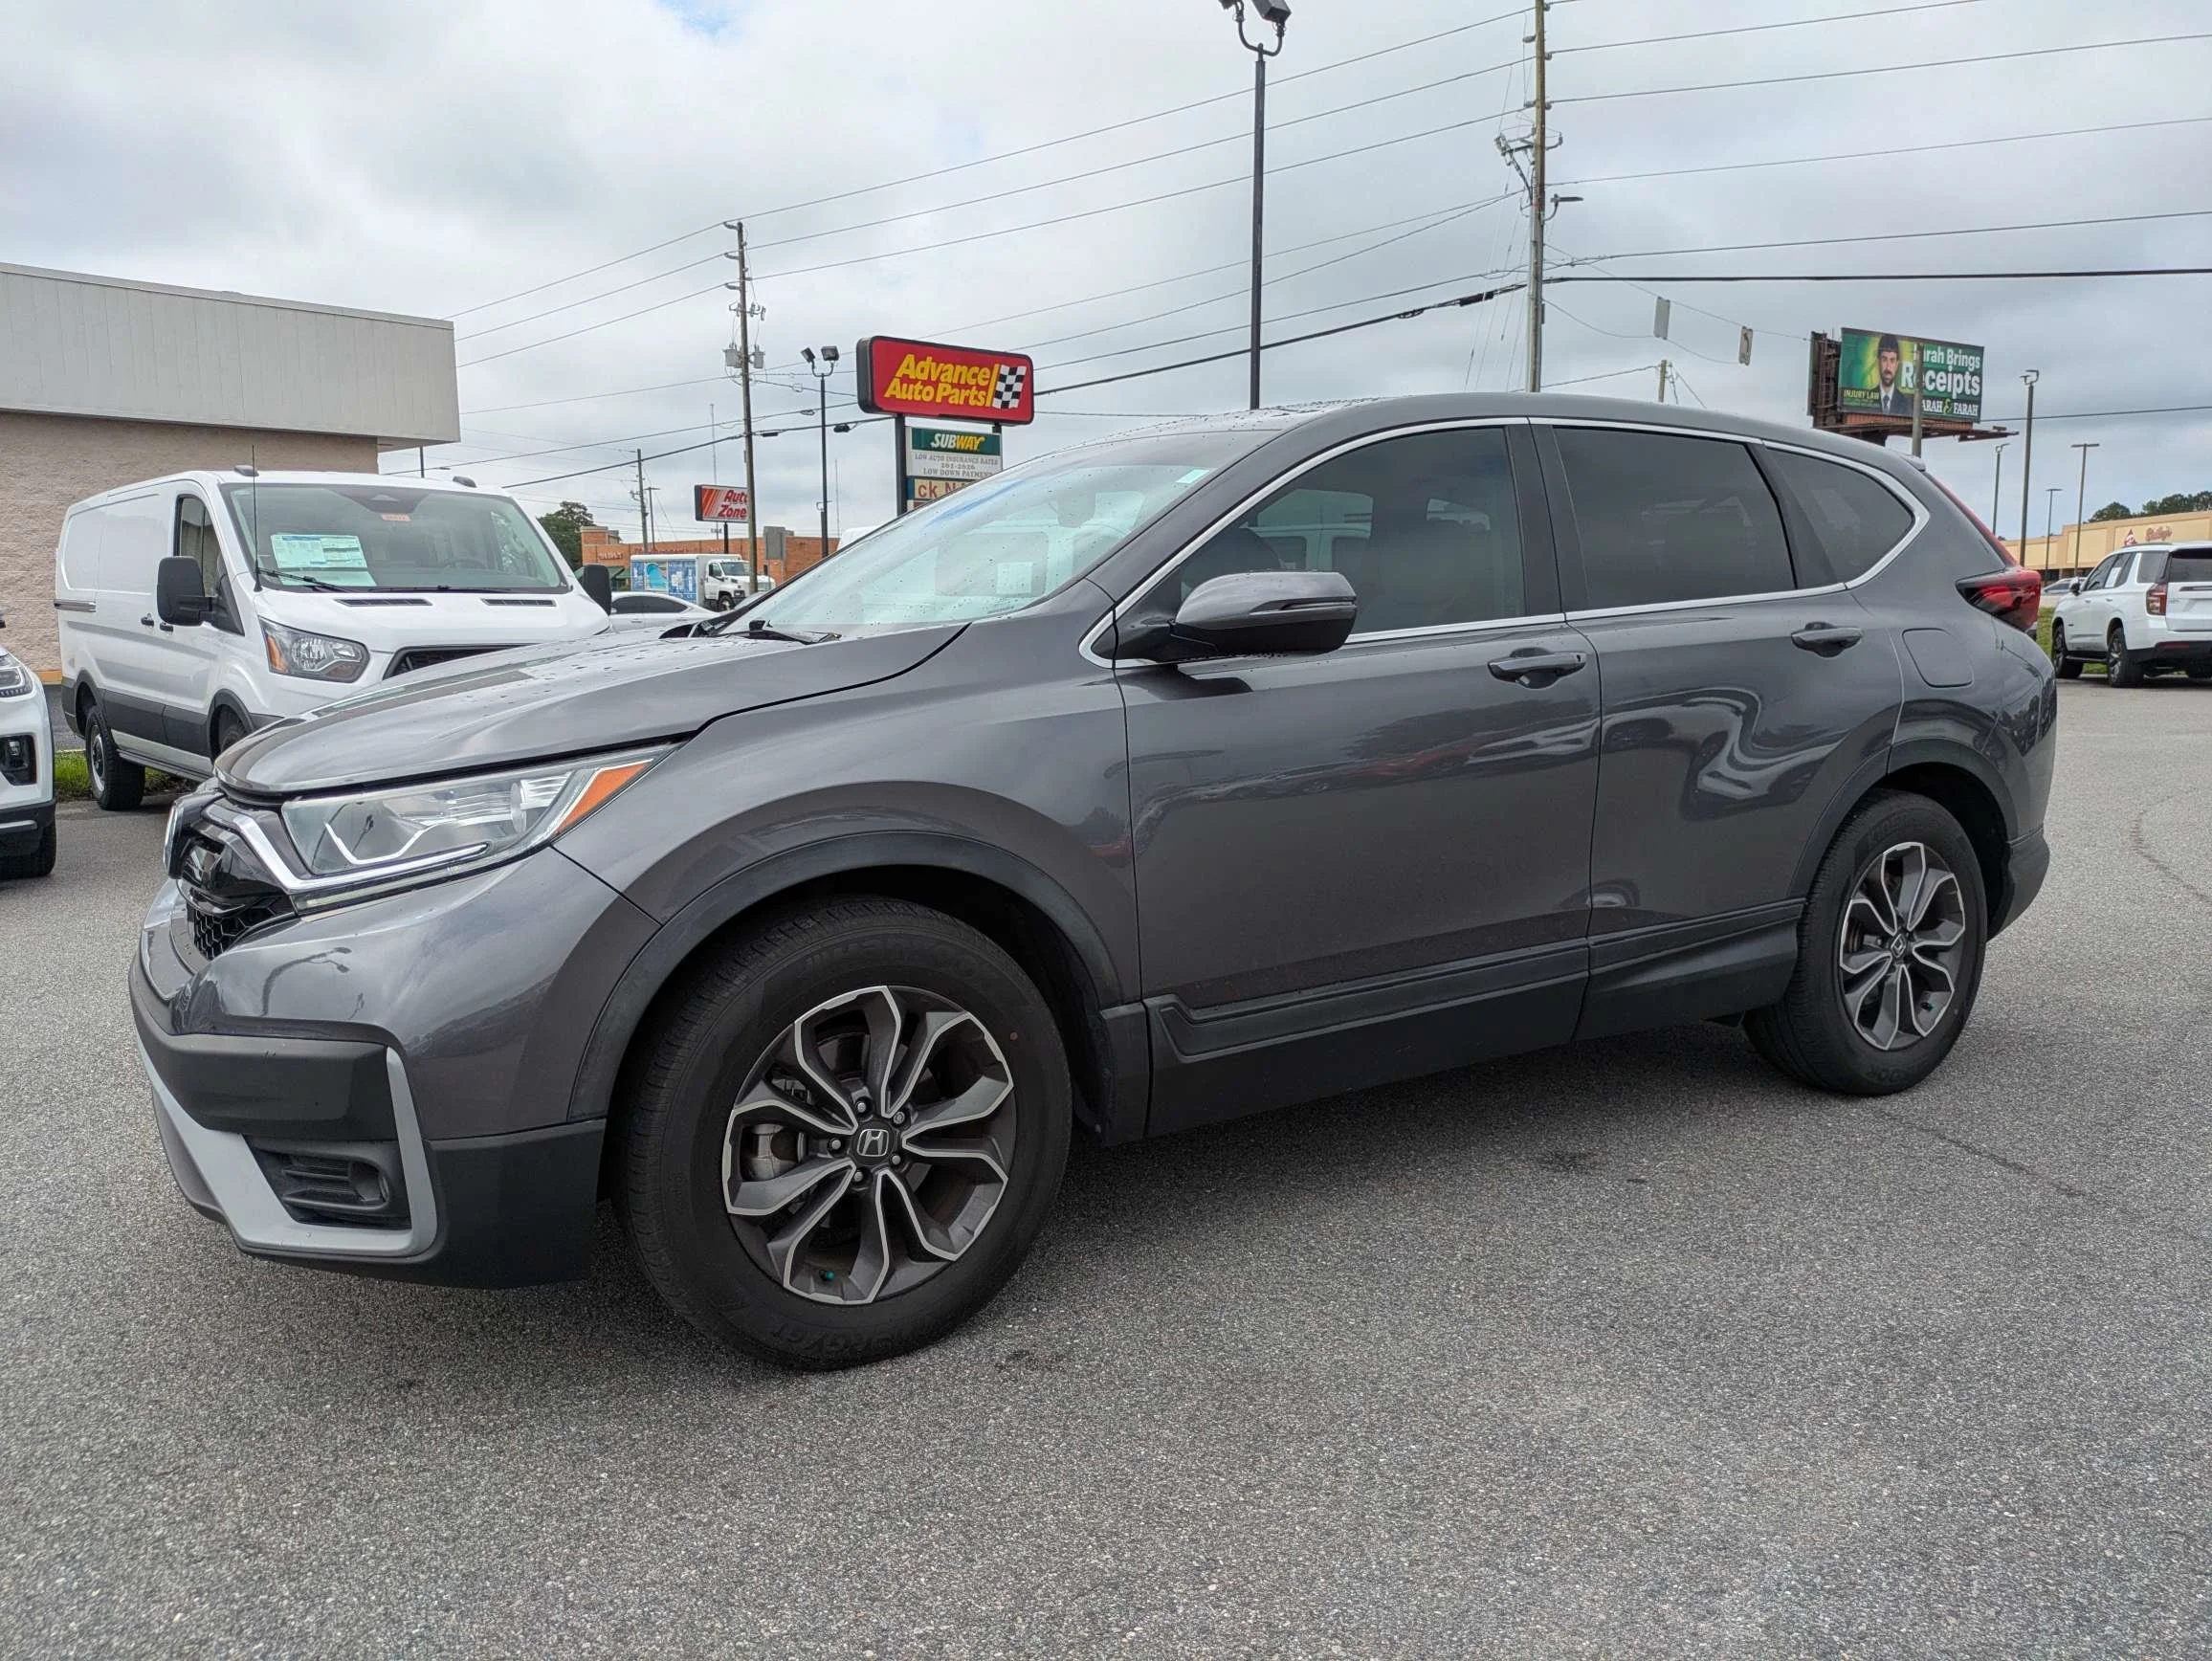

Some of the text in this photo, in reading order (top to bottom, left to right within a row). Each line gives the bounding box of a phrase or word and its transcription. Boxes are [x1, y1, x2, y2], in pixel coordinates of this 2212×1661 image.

[896, 353, 991, 387] Advance
[1946, 348, 1980, 371] Brings
[1901, 362, 1980, 400] Rceipts
[884, 377, 986, 407] Auto Parts
[1921, 398, 1979, 416] ARAH & FARAH
[930, 432, 985, 451] SUBWAY
[940, 469, 961, 477] DOWN
[719, 504, 747, 518] Zone
